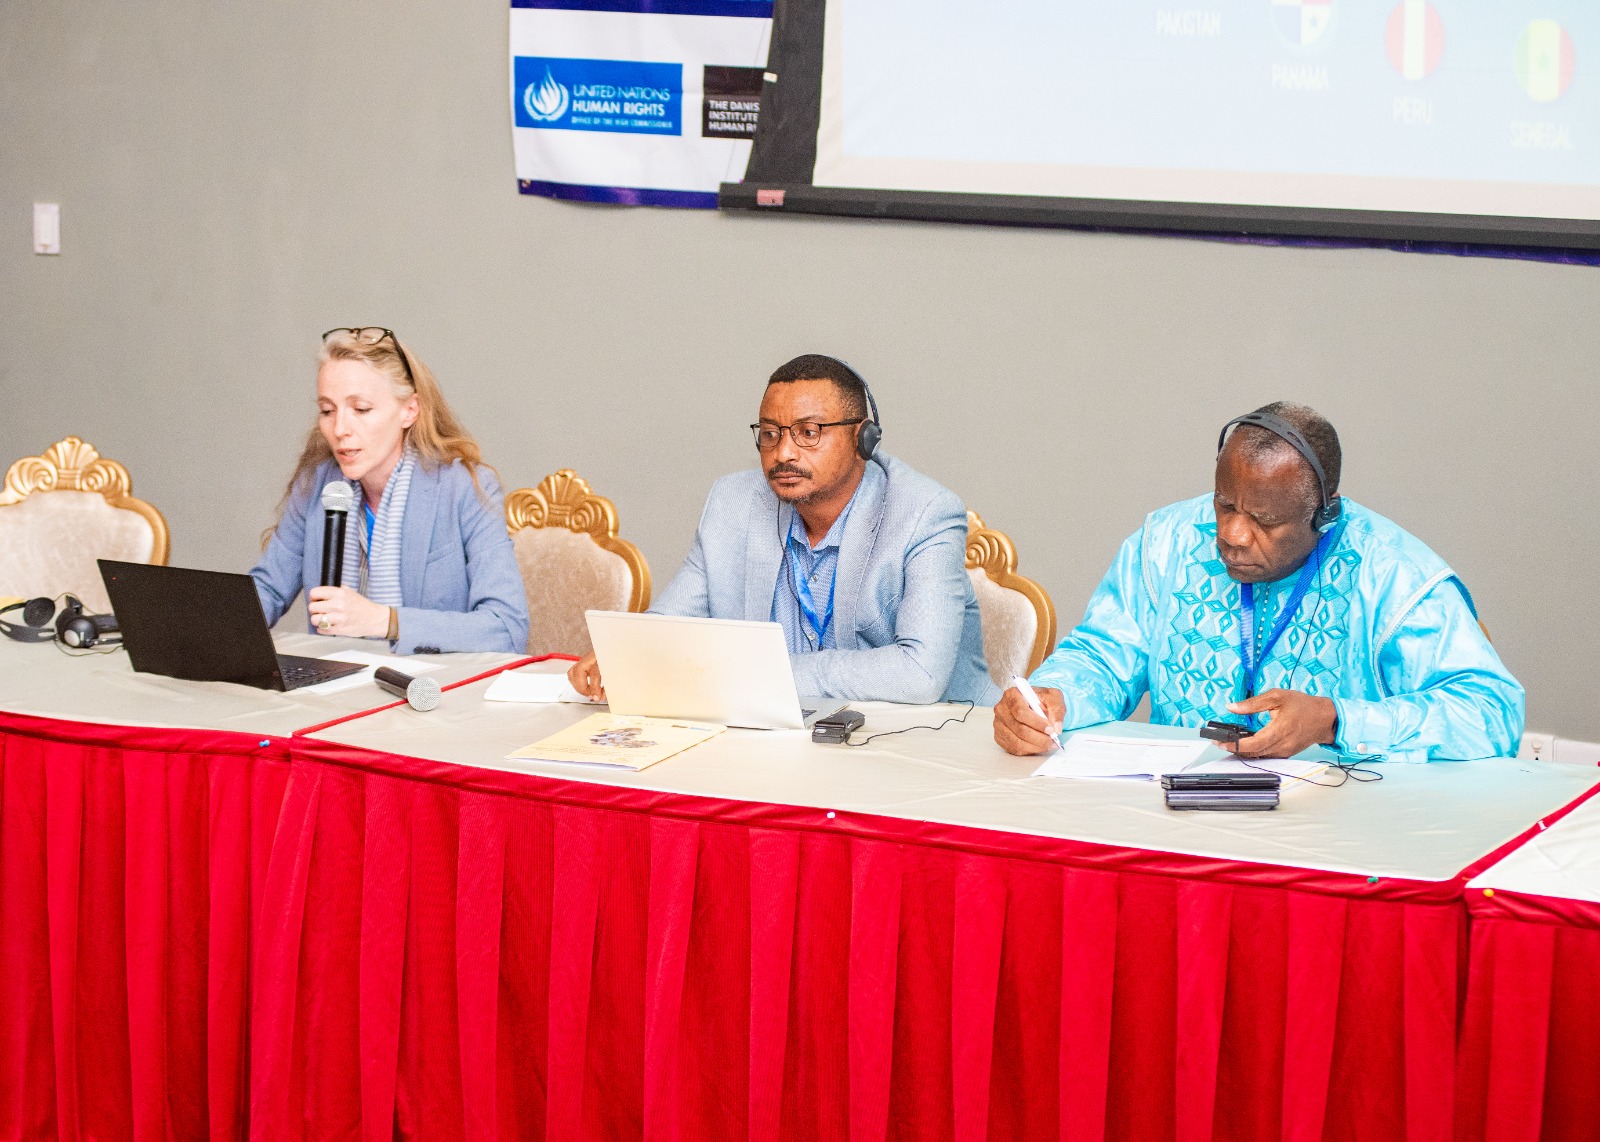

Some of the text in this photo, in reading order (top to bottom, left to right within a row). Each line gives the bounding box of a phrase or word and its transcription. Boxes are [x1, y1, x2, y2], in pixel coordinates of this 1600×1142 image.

[1156, 11, 1221, 37] PAKISTAN
[1271, 64, 1329, 91] PANAMA
[573, 84, 671, 102] UNITED NATIONS
[572, 100, 665, 117] HUMAN RIGHTS
[708, 100, 760, 112] THE DANIS
[1392, 98, 1433, 125] PERU
[708, 110, 758, 122] INSTITUTE
[708, 121, 745, 132] HUMAN
[1510, 121, 1575, 151] SENEGAL
